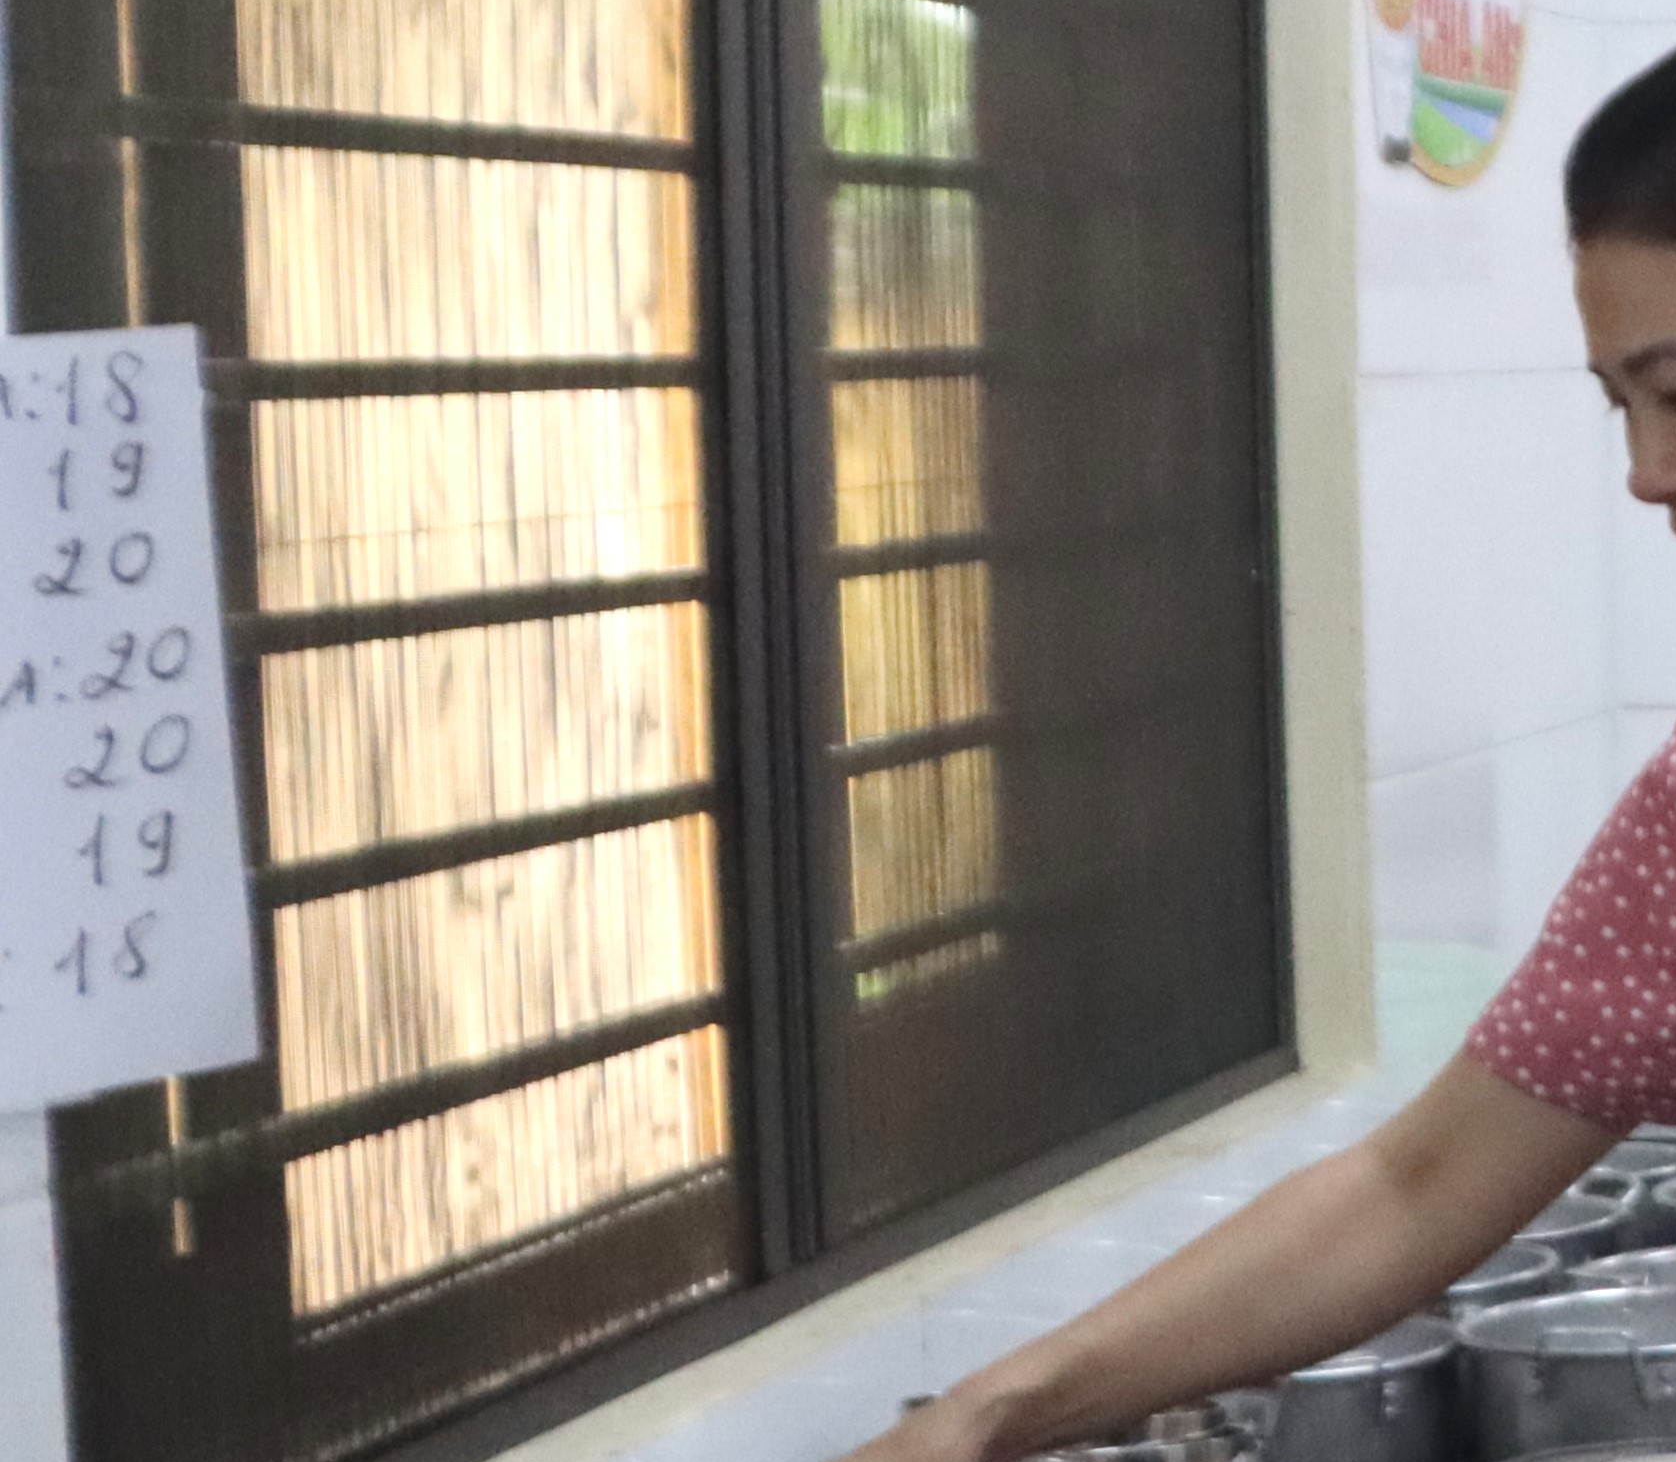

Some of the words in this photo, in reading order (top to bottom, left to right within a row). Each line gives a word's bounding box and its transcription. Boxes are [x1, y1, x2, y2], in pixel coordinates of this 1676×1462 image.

[49, 440, 144, 511] 19
[34, 531, 154, 596] 20
[79, 622, 192, 701] 20
[63, 712, 191, 789] 20
[78, 809, 176, 886] 19
